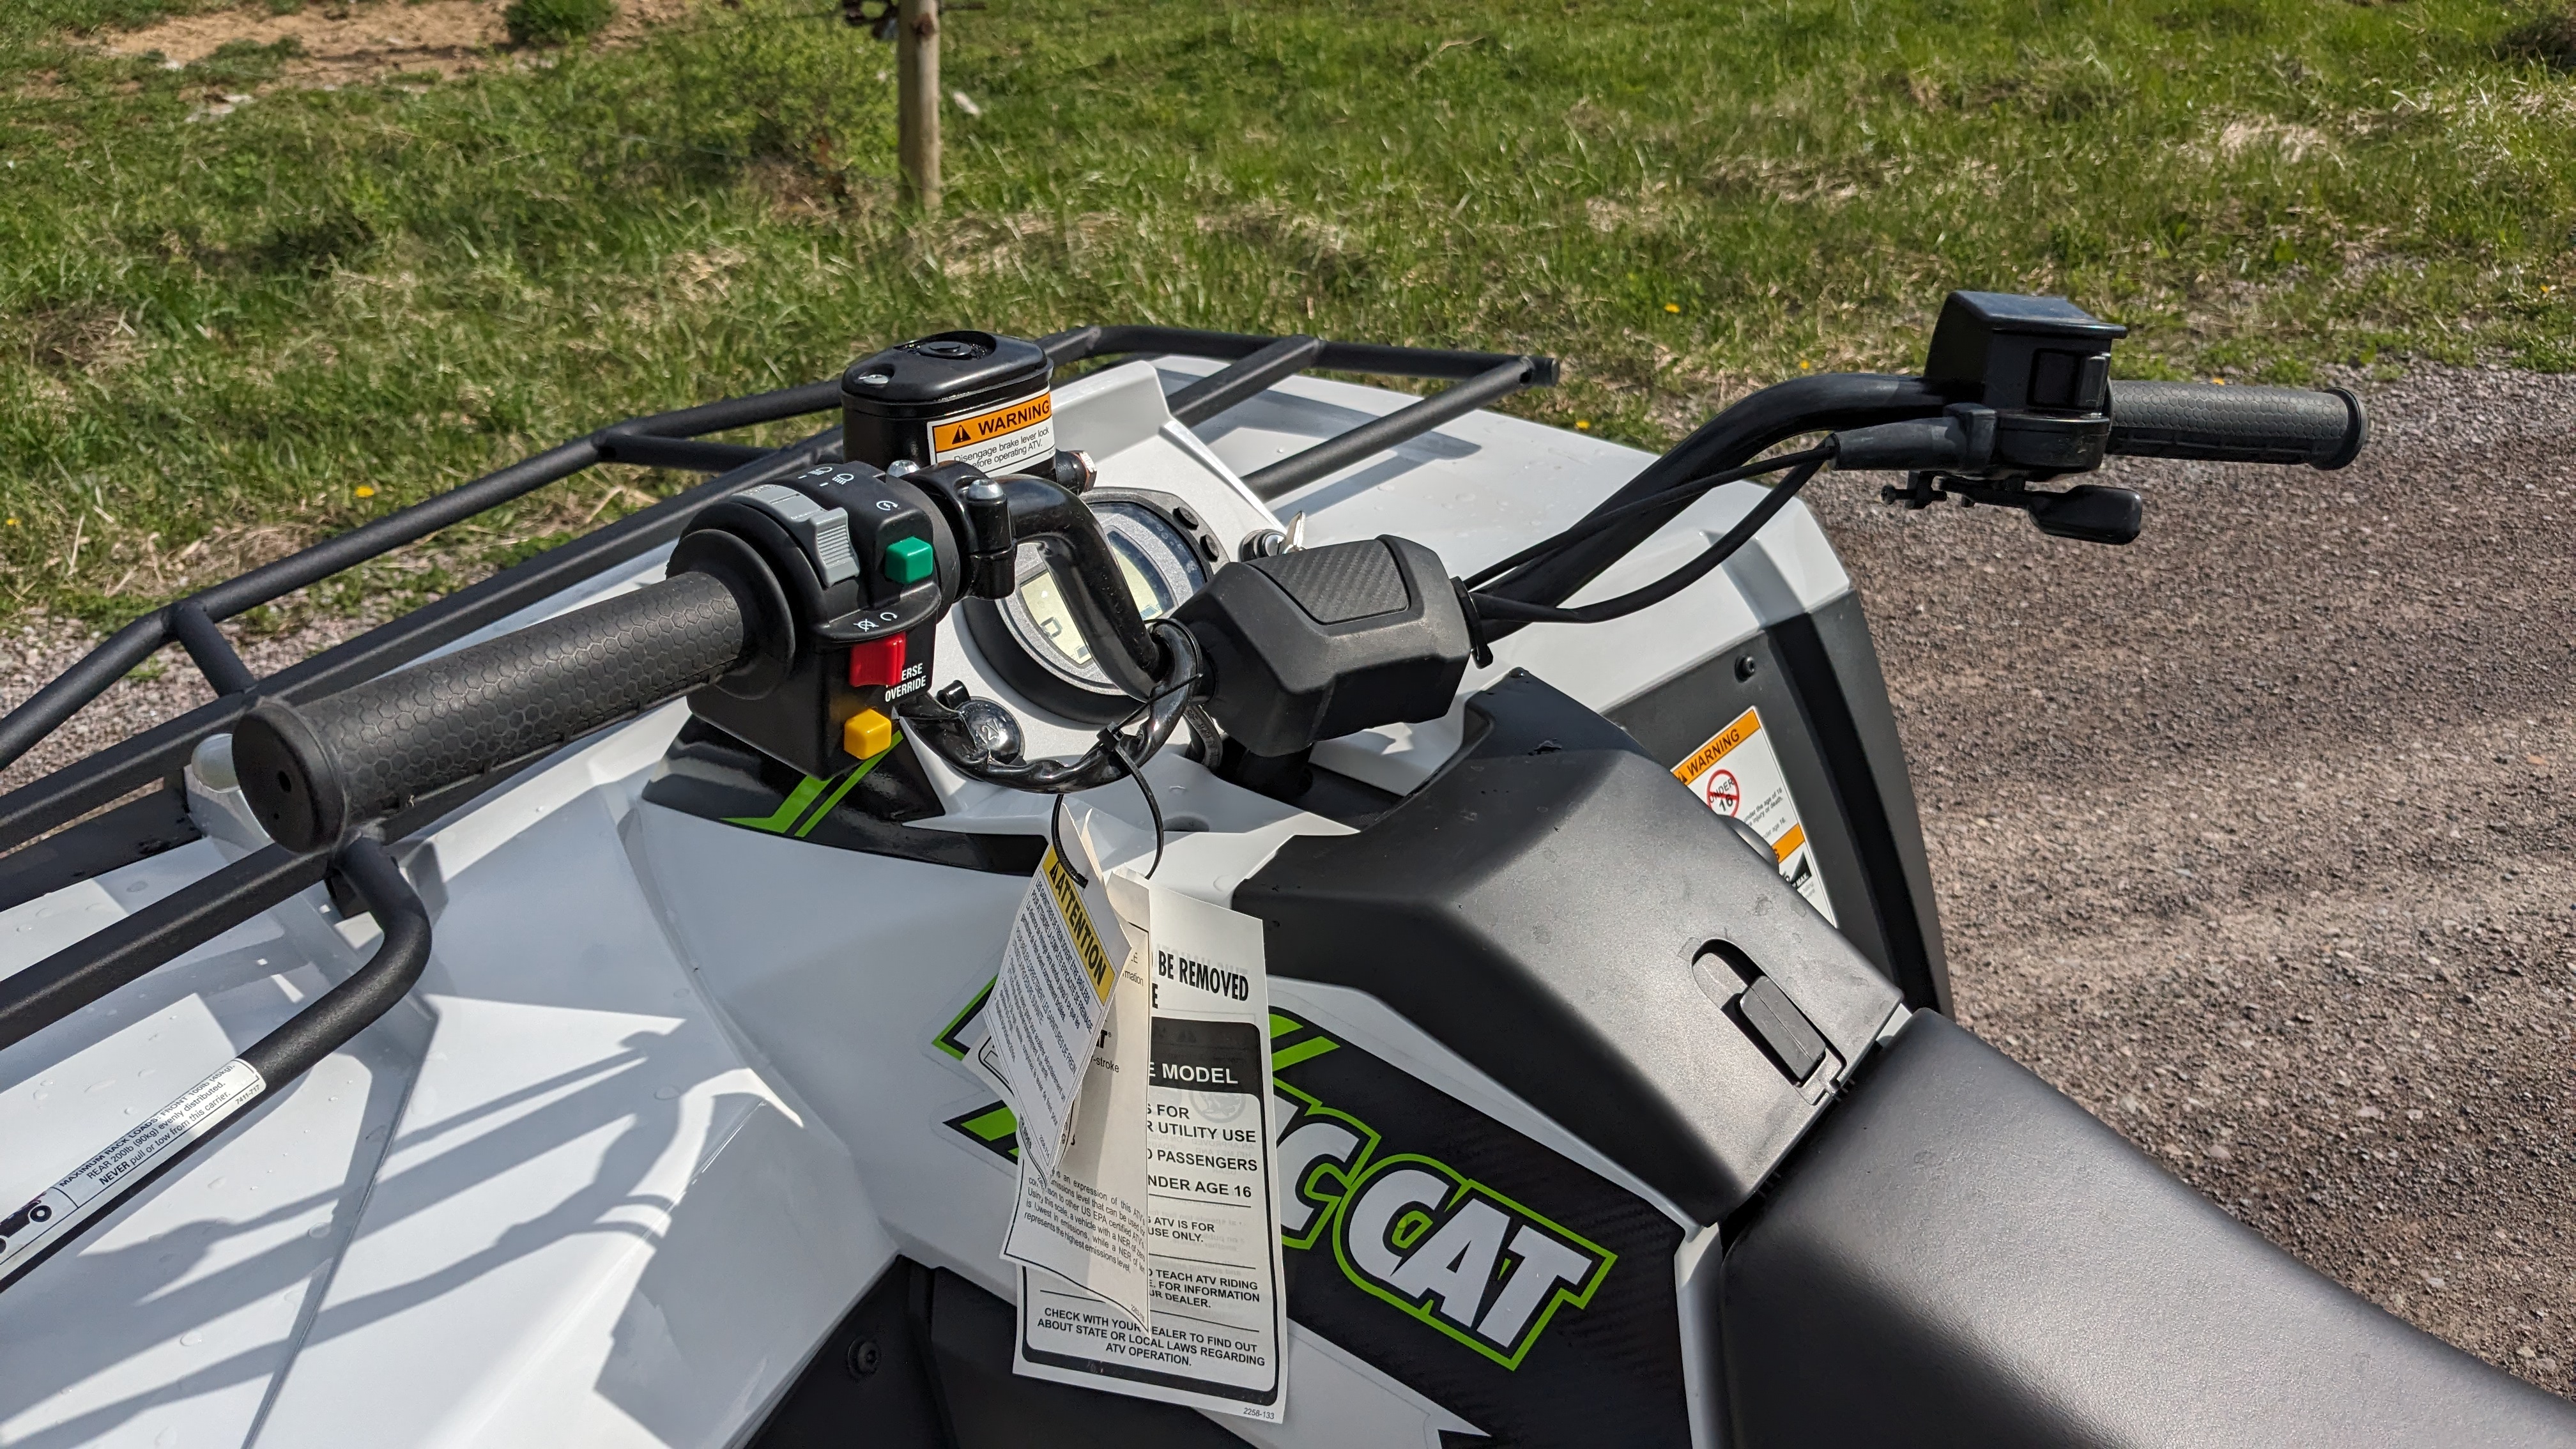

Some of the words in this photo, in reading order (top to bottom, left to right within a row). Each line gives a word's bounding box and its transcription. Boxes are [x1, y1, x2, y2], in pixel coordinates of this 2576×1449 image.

[978, 400, 1049, 435] WARNING
[954, 447, 997, 462] Disengage
[999, 438, 1018, 451] brake
[1021, 434, 1036, 445] lever
[1037, 427, 1049, 439] lock
[973, 457, 992, 469] efore
[994, 446, 1027, 464] operating
[1027, 439, 1042, 452] ATV.
[901, 663, 923, 681] ERSE
[885, 675, 926, 702] OVERRIDE
[975, 718, 1000, 744] 12V
[1687, 728, 1739, 777] WARNING
[1708, 777, 1734, 804] UNDER
[1717, 792, 1735, 813] 16
[1755, 802, 1763, 812] the
[1763, 796, 1772, 808] age
[1770, 791, 1776, 799] of
[1776, 786, 1782, 795] 16
[1752, 810, 1765, 825] injury
[1769, 794, 1783, 809] death.
[1054, 873, 1107, 987] ATTENTION
[1123, 970, 1143, 986] mation
[1159, 950, 1174, 980] BE
[1179, 957, 1248, 1001] REMOVED
[1091, 1055, 1119, 1073] r-stroke
[1162, 1063, 1238, 1084] MODEL
[235, 1085, 261, 1104] 7411-717
[1157, 1104, 1190, 1119] FOR
[60, 1153, 105, 1188] MAXIMUM
[105, 1137, 128, 1155] RACK
[128, 1116, 160, 1138] LOADS:
[161, 1096, 188, 1116] FRONT
[88, 1160, 111, 1179] REAR
[111, 1144, 133, 1162] 200lb
[133, 1127, 158, 1148] (90kg)
[158, 1110, 183, 1130] evenly
[183, 1079, 226, 1112] distributed.
[100, 1160, 130, 1185] NEVER
[129, 1149, 146, 1165] pull
[146, 1144, 155, 1153] or
[155, 1132, 171, 1146] tow
[170, 1119, 189, 1135] from
[189, 1108, 204, 1121] this
[204, 1090, 230, 1110] carrier.
[1158, 1121, 1217, 1139] UTILITY
[1223, 1129, 1256, 1142] USE
[1157, 1149, 1257, 1171] PASSENGERS
[1064, 1175, 1070, 1184] an
[1073, 1180, 1107, 1200] expression
[1121, 1200, 1131, 1213] this
[1148, 1174, 1190, 1191] NDER
[1195, 1181, 1229, 1195] AGE
[1234, 1186, 1252, 1197] 16
[1059, 1193, 1064, 1202] to
[1065, 1199, 1079, 1211] other
[1081, 1206, 1091, 1216] US
[1093, 1211, 1107, 1224] EPA
[1109, 1220, 1131, 1237] certified
[1076, 1191, 1090, 1204] level
[1092, 1199, 1104, 1211] that
[1106, 1207, 1117, 1217] can
[1119, 1211, 1126, 1222] be
[1026, 1198, 1031, 1208] is
[1054, 1213, 1058, 1222] in
[1061, 1219, 1089, 1241] emissions,
[1092, 1235, 1108, 1248] while
[1119, 1246, 1131, 1261] NER
[1045, 1196, 1053, 1208] this
[1055, 1204, 1069, 1218] scale,
[1075, 1215, 1096, 1230] vehicle
[1098, 1225, 1110, 1238] with
[1117, 1234, 1130, 1249] NER
[1148, 1227, 1169, 1237] USE
[1172, 1230, 1204, 1242] ONLY.
[1154, 1216, 1174, 1227] ATV
[1178, 1220, 1188, 1229] IS
[1192, 1222, 1215, 1232] FOR
[1024, 1212, 1055, 1232] represents
[1064, 1230, 1084, 1250] highest
[1085, 1244, 1117, 1264] emissions
[1117, 1257, 1131, 1273] level.
[1346, 1167, 1595, 1350] CAT
[1156, 1269, 1192, 1282] TEACH
[1196, 1275, 1216, 1285] ATV
[1220, 1278, 1257, 1290] RIDING
[1159, 1281, 1181, 1292] FOR
[1184, 1285, 1260, 1302] INFORMATION
[1165, 1293, 1211, 1308] DEALER.
[1038, 1319, 1073, 1335] ABOUT
[1075, 1326, 1107, 1338] STATE
[1110, 1331, 1125, 1341] OR
[1128, 1334, 1164, 1349] LOCAL
[1167, 1340, 1197, 1354] LAWS
[1200, 1346, 1265, 1366] REGARDING
[1045, 1307, 1080, 1322] CHECK
[1083, 1314, 1108, 1326] WITH
[1151, 1326, 1186, 1340] EALER
[1190, 1333, 1204, 1342] TO
[1208, 1337, 1231, 1348] FIND
[1235, 1341, 1257, 1353] OUT
[1105, 1343, 1126, 1354] ATV
[1128, 1347, 1192, 1366] OPERATION.
[1243, 1407, 1275, 1420] 2258-133
